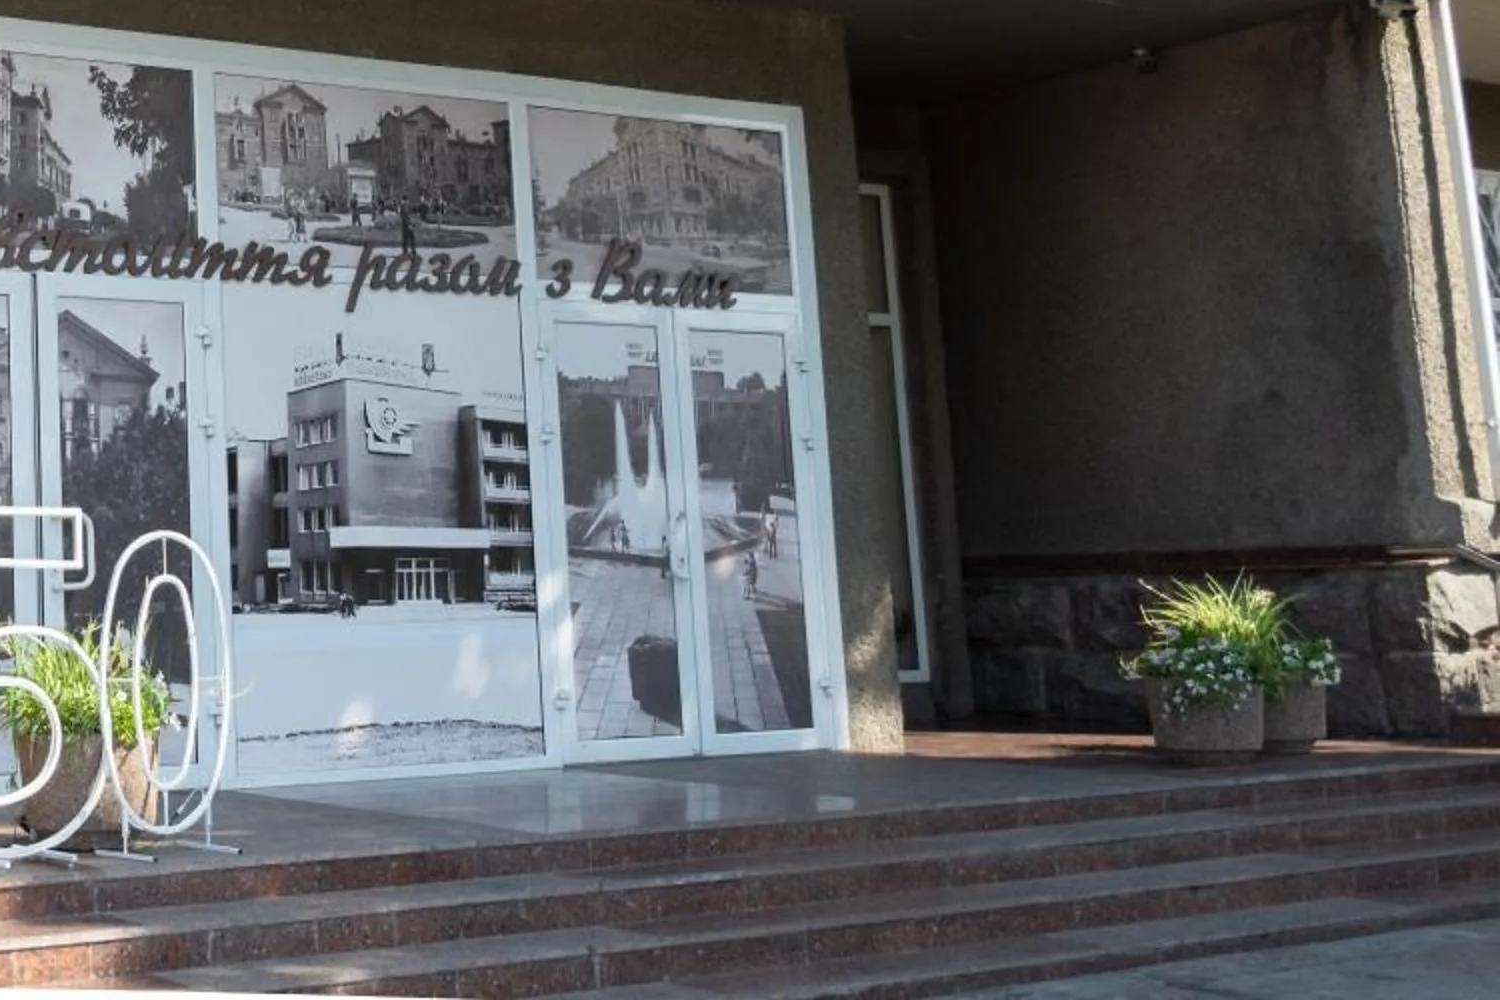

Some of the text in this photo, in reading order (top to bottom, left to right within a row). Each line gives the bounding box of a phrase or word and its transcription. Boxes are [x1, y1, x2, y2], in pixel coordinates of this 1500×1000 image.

[344, 241, 522, 313] разом
[545, 257, 574, 299] з
[590, 236, 738, 311] Вами
